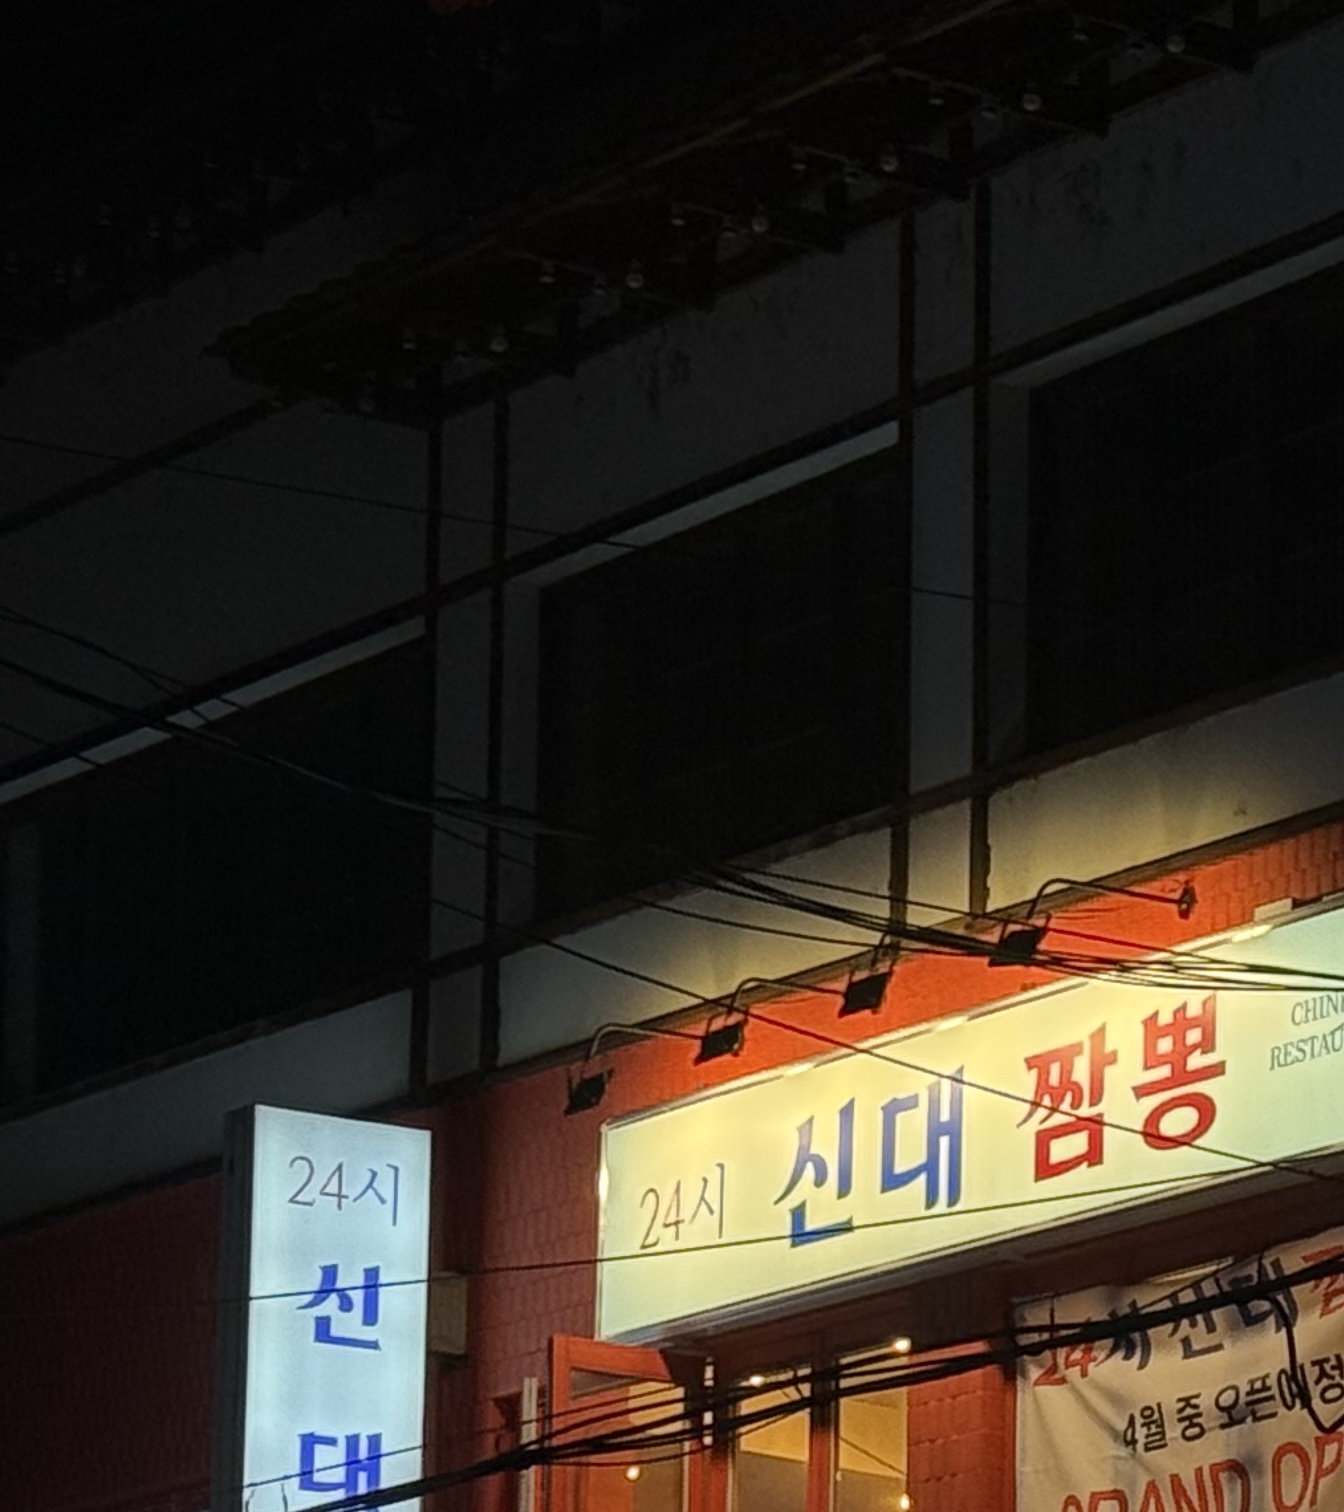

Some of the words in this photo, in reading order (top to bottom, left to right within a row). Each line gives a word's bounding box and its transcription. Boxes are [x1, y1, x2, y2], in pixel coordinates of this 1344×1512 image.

[640, 1162, 726, 1248] 24시
[773, 1064, 964, 1247] 신대
[1017, 993, 1226, 1182] 짬뽕
[288, 1155, 401, 1227] 24시
[1123, 1402, 1168, 1453] 4월
[1176, 1394, 1206, 1442] 중
